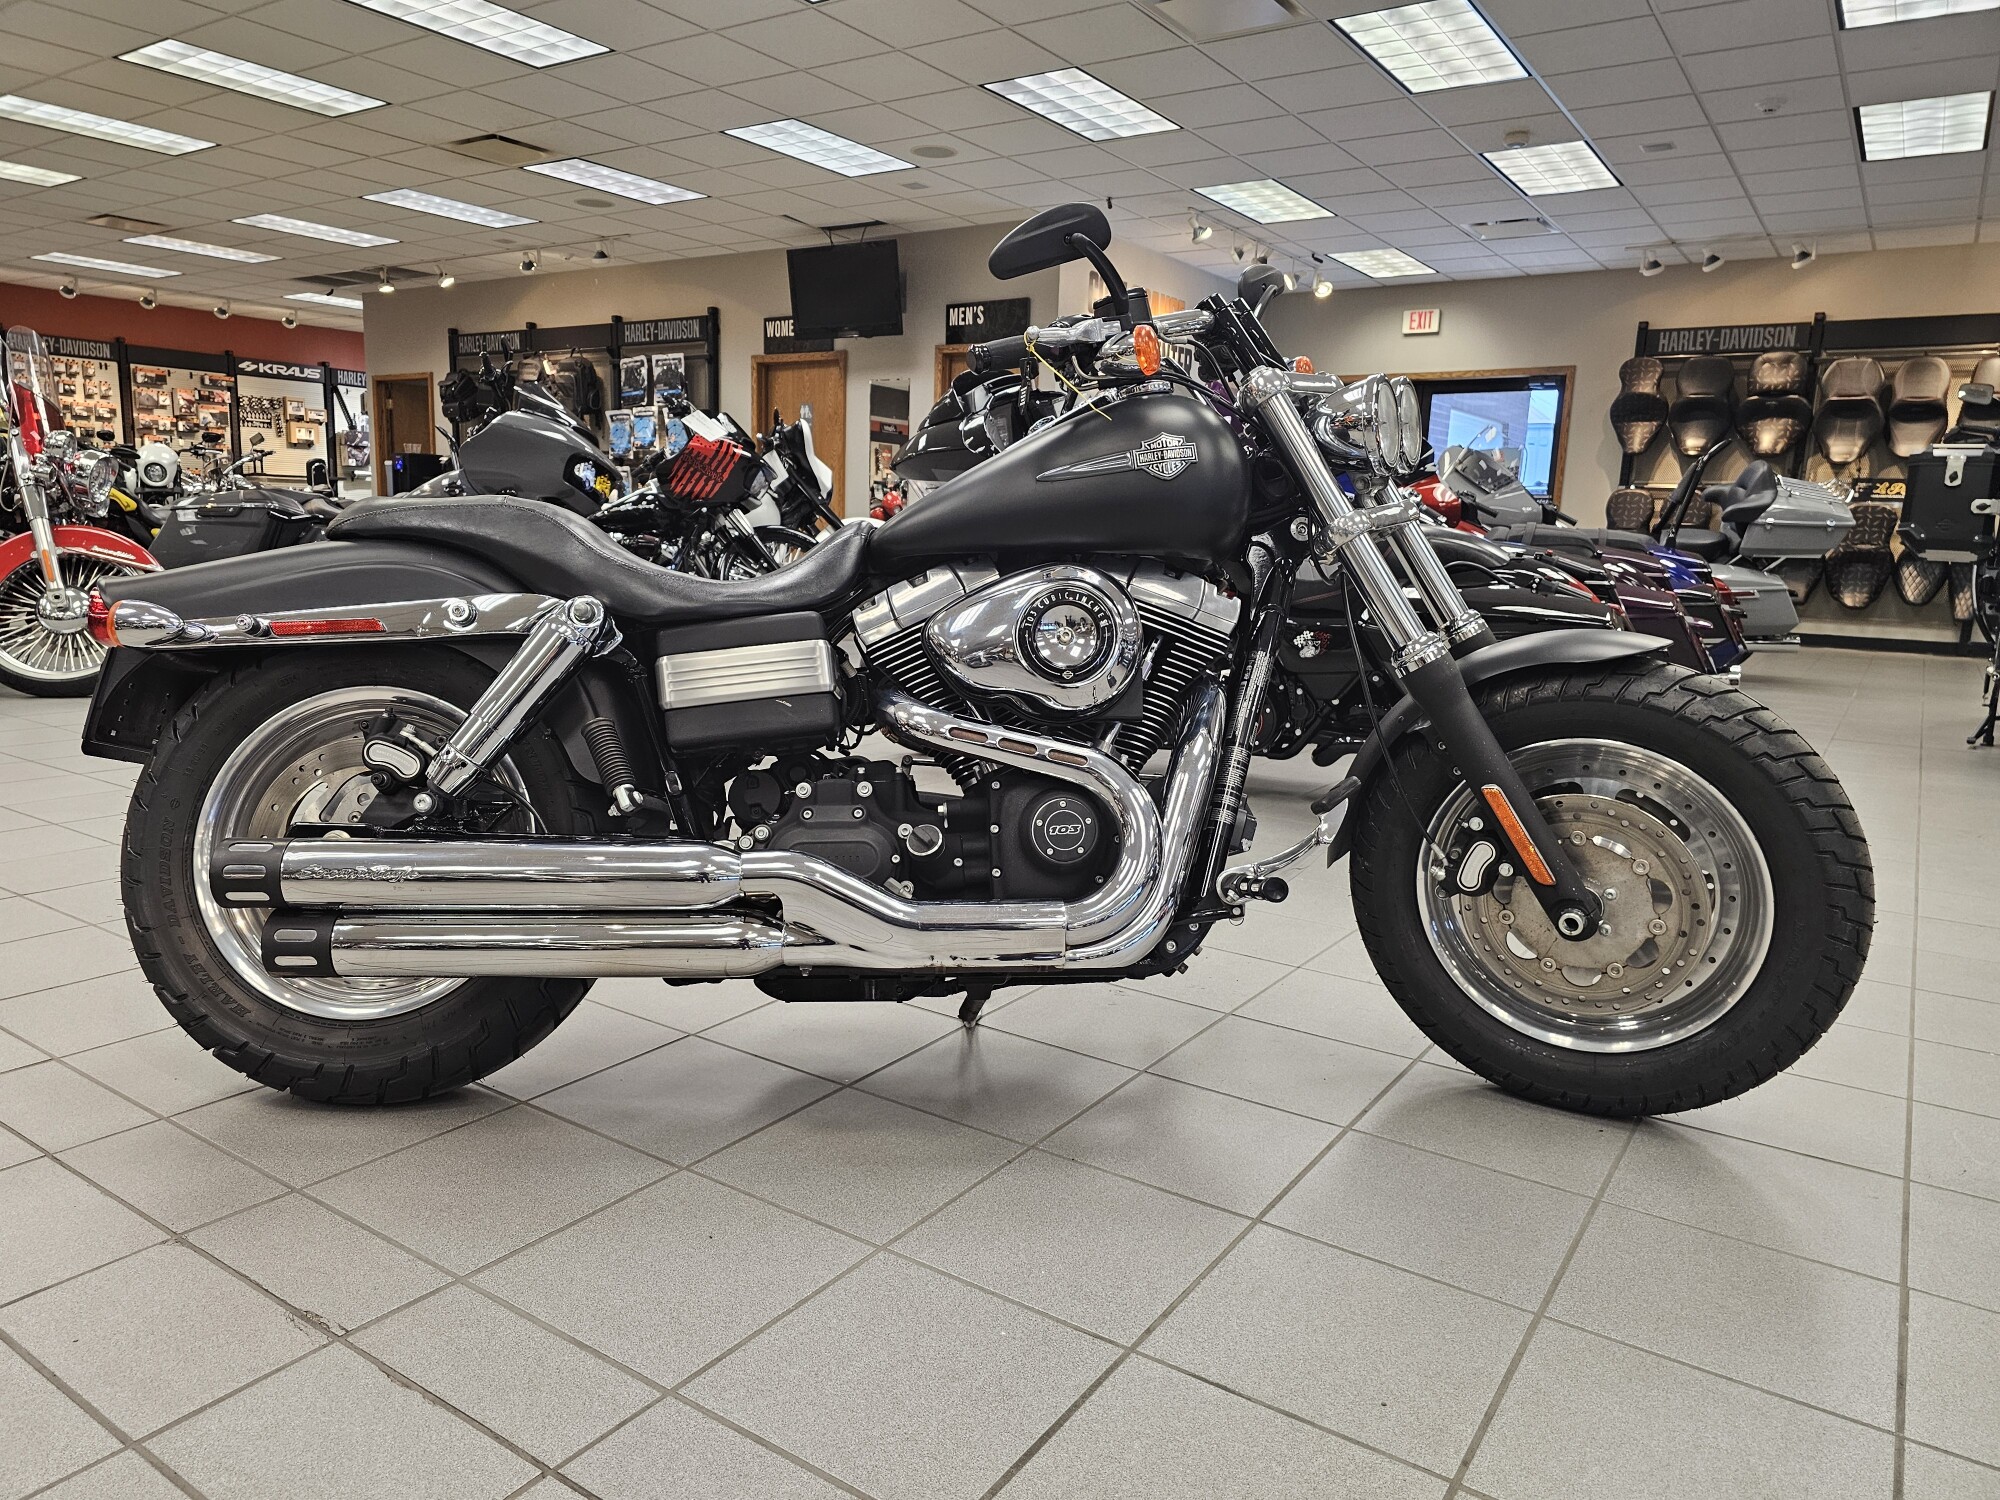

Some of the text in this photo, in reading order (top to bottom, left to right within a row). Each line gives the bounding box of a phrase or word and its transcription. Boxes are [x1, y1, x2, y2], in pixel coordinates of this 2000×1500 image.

[949, 305, 985, 326] MEN'S
[1409, 310, 1434, 330] EXIT
[624, 319, 700, 342] HARLEY-DAVIDSON
[1658, 325, 1797, 352] HARLEY-DAVIDSON
[258, 362, 322, 379] KRAUS
[1139, 447, 1193, 463] HARLEY-DAVIDSON
[1153, 461, 1183, 474] CYCLES
[1024, 592, 1110, 628] 103 CUBIC INCHES
[1048, 824, 1082, 836] 103
